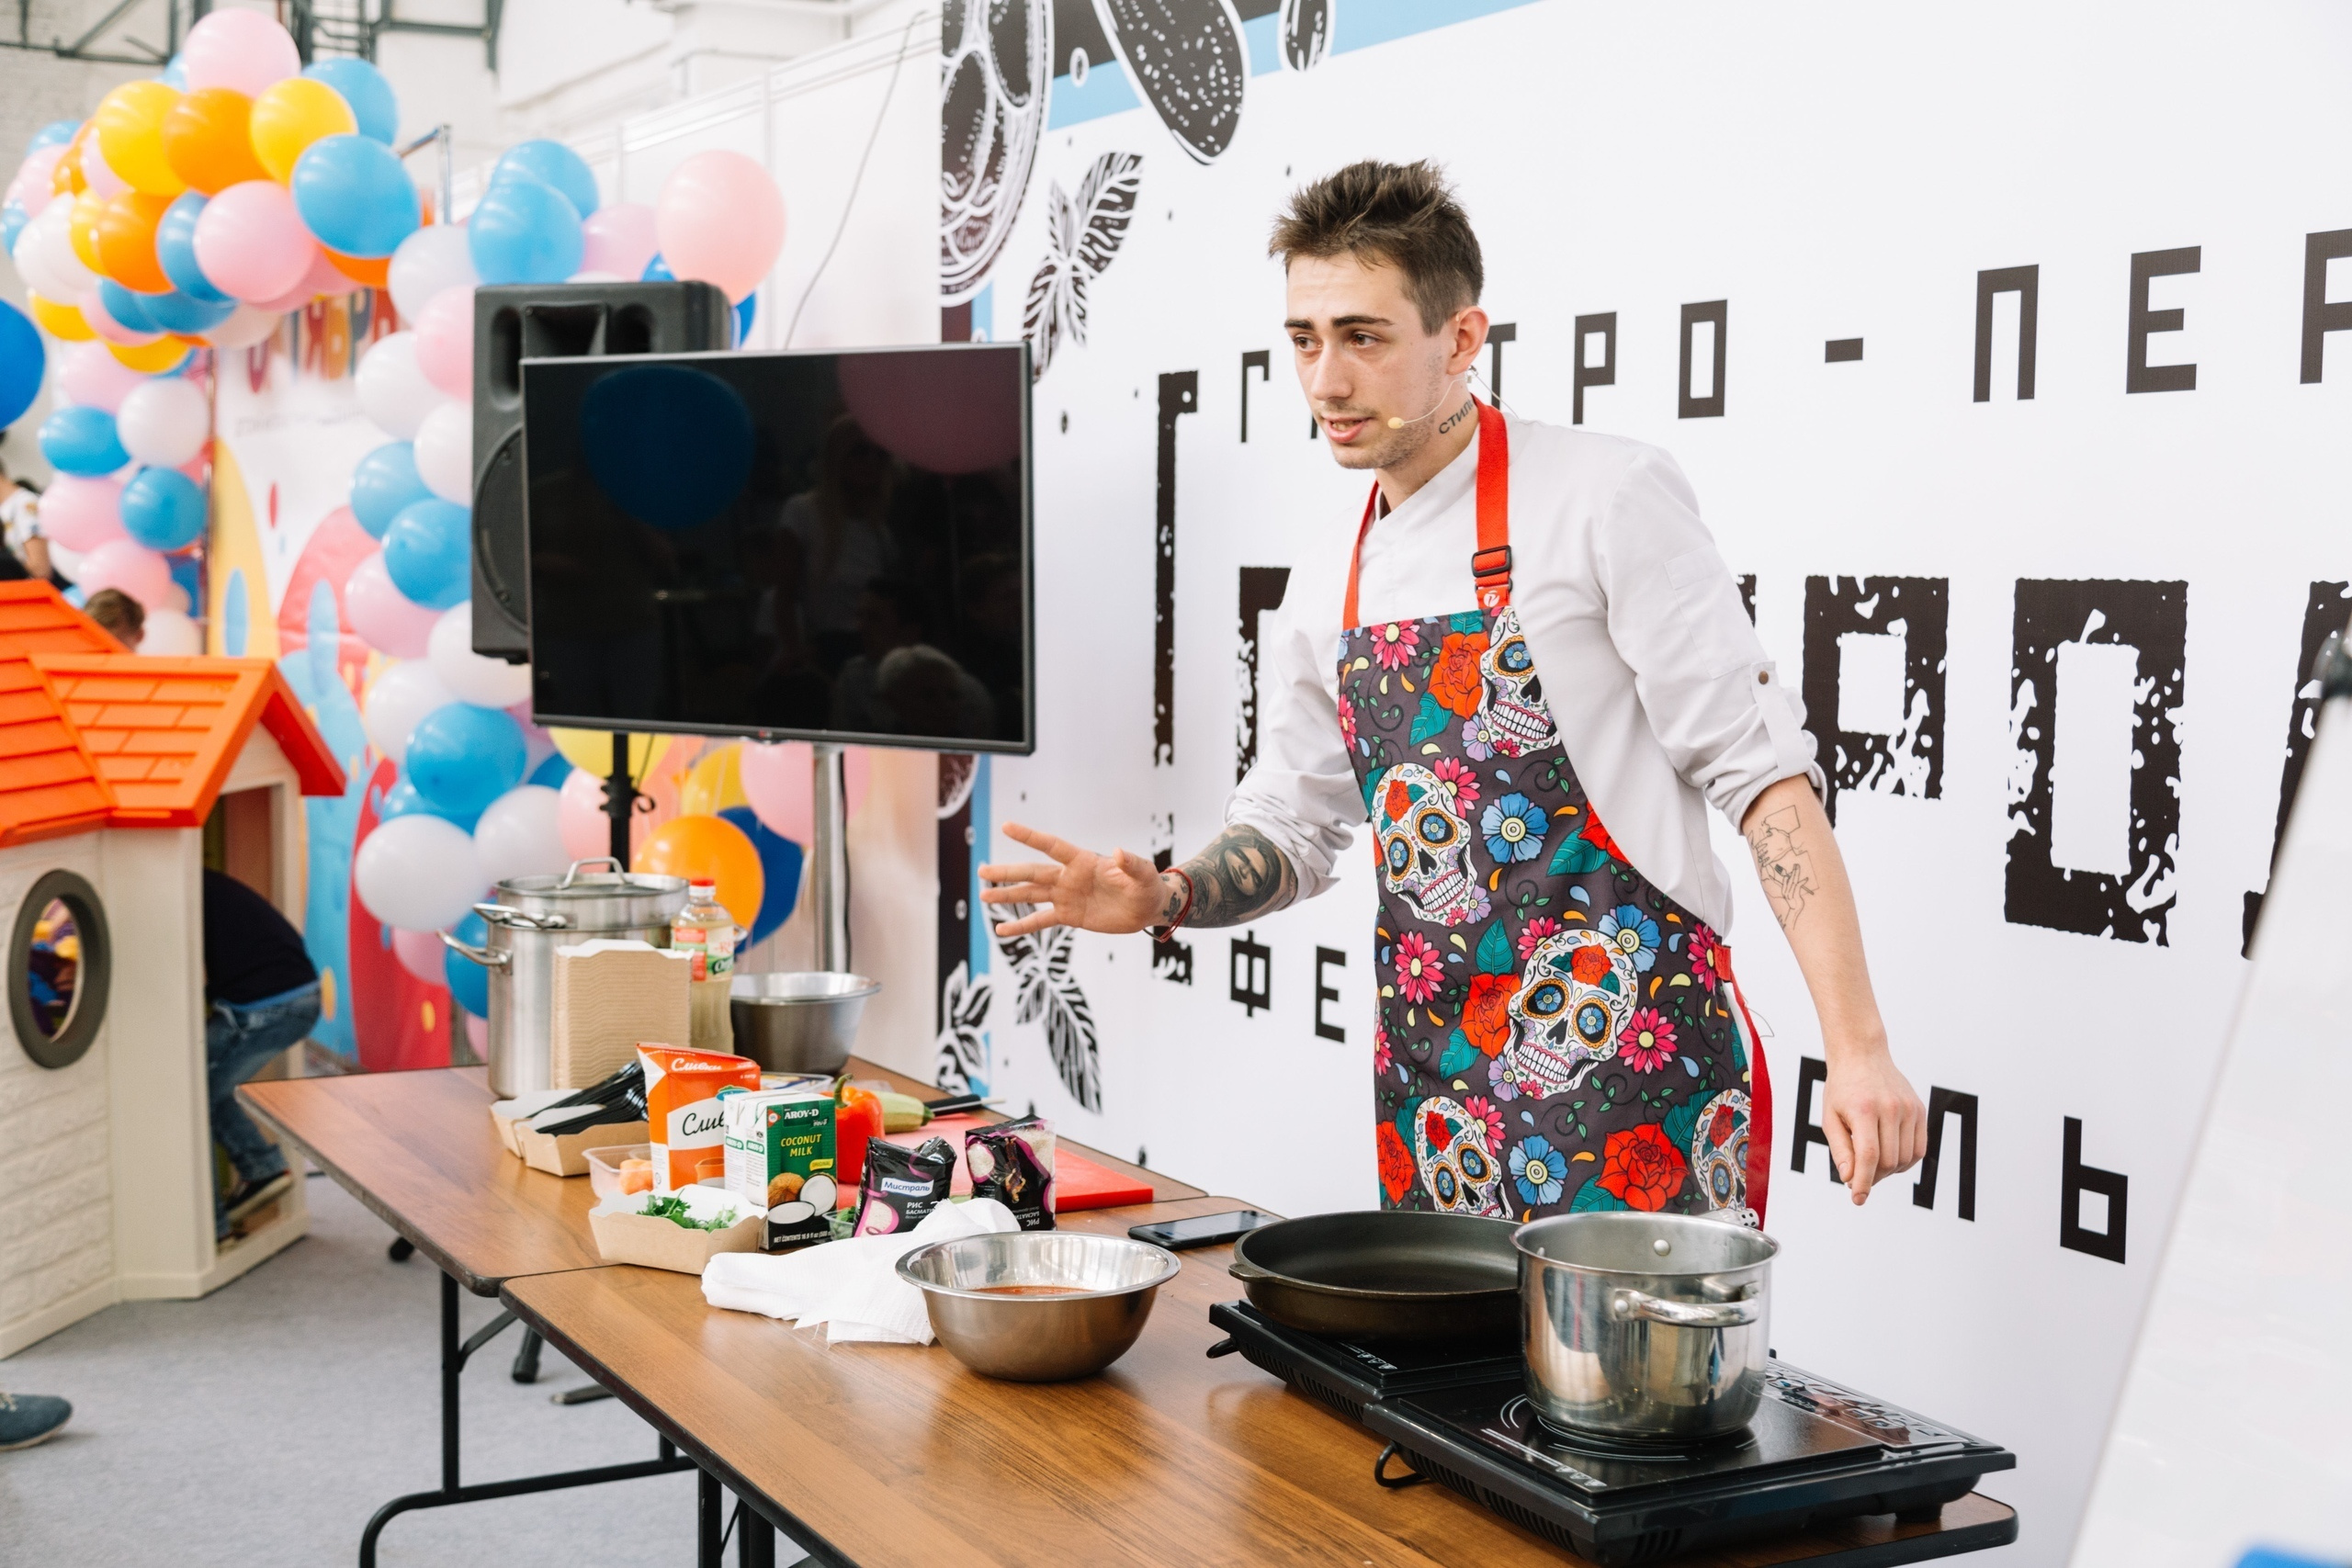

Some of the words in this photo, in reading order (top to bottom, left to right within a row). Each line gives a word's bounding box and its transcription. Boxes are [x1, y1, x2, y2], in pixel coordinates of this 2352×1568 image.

[671, 1057, 722, 1072] Сливки
[784, 1109, 820, 1120] AROY-D
[781, 1134, 821, 1147] COCONUT
[789, 1146, 812, 1157] MILK
[884, 1181, 931, 1192] Мистраль
